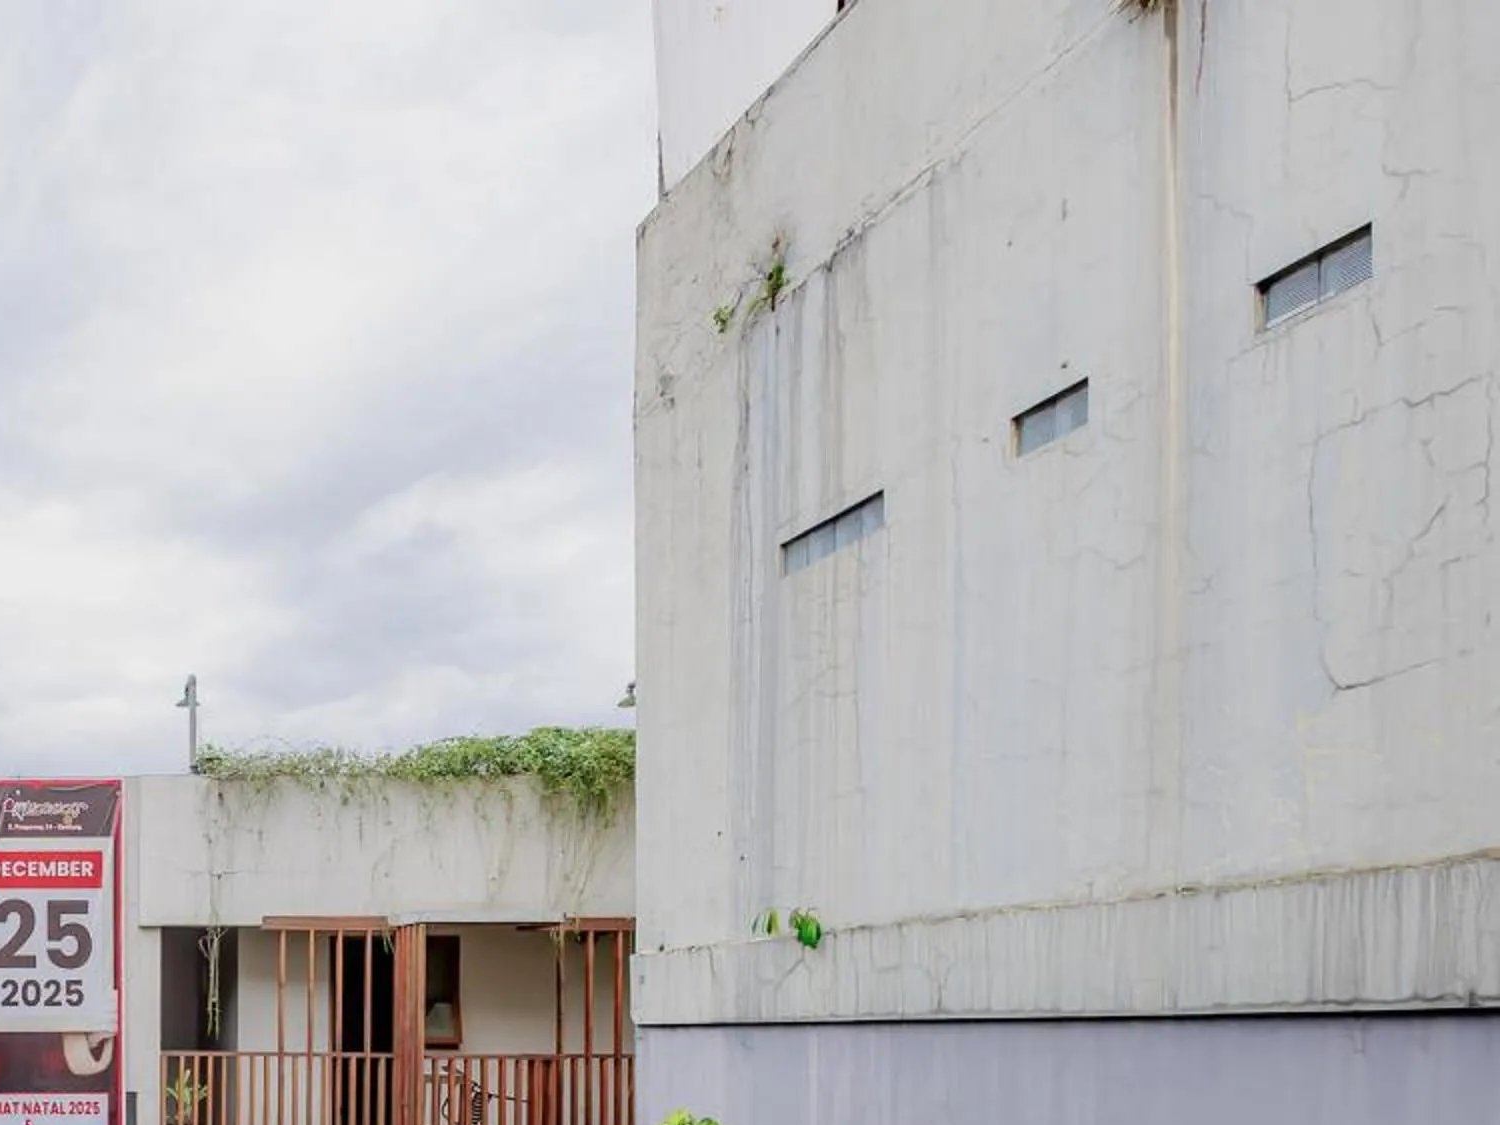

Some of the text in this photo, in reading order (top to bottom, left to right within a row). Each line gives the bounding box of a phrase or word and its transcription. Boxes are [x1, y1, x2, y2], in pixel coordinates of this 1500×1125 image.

[1, 979, 85, 1007] 2025
[22, 1101, 66, 1115] NATAL
[68, 1101, 100, 1115] 2025
